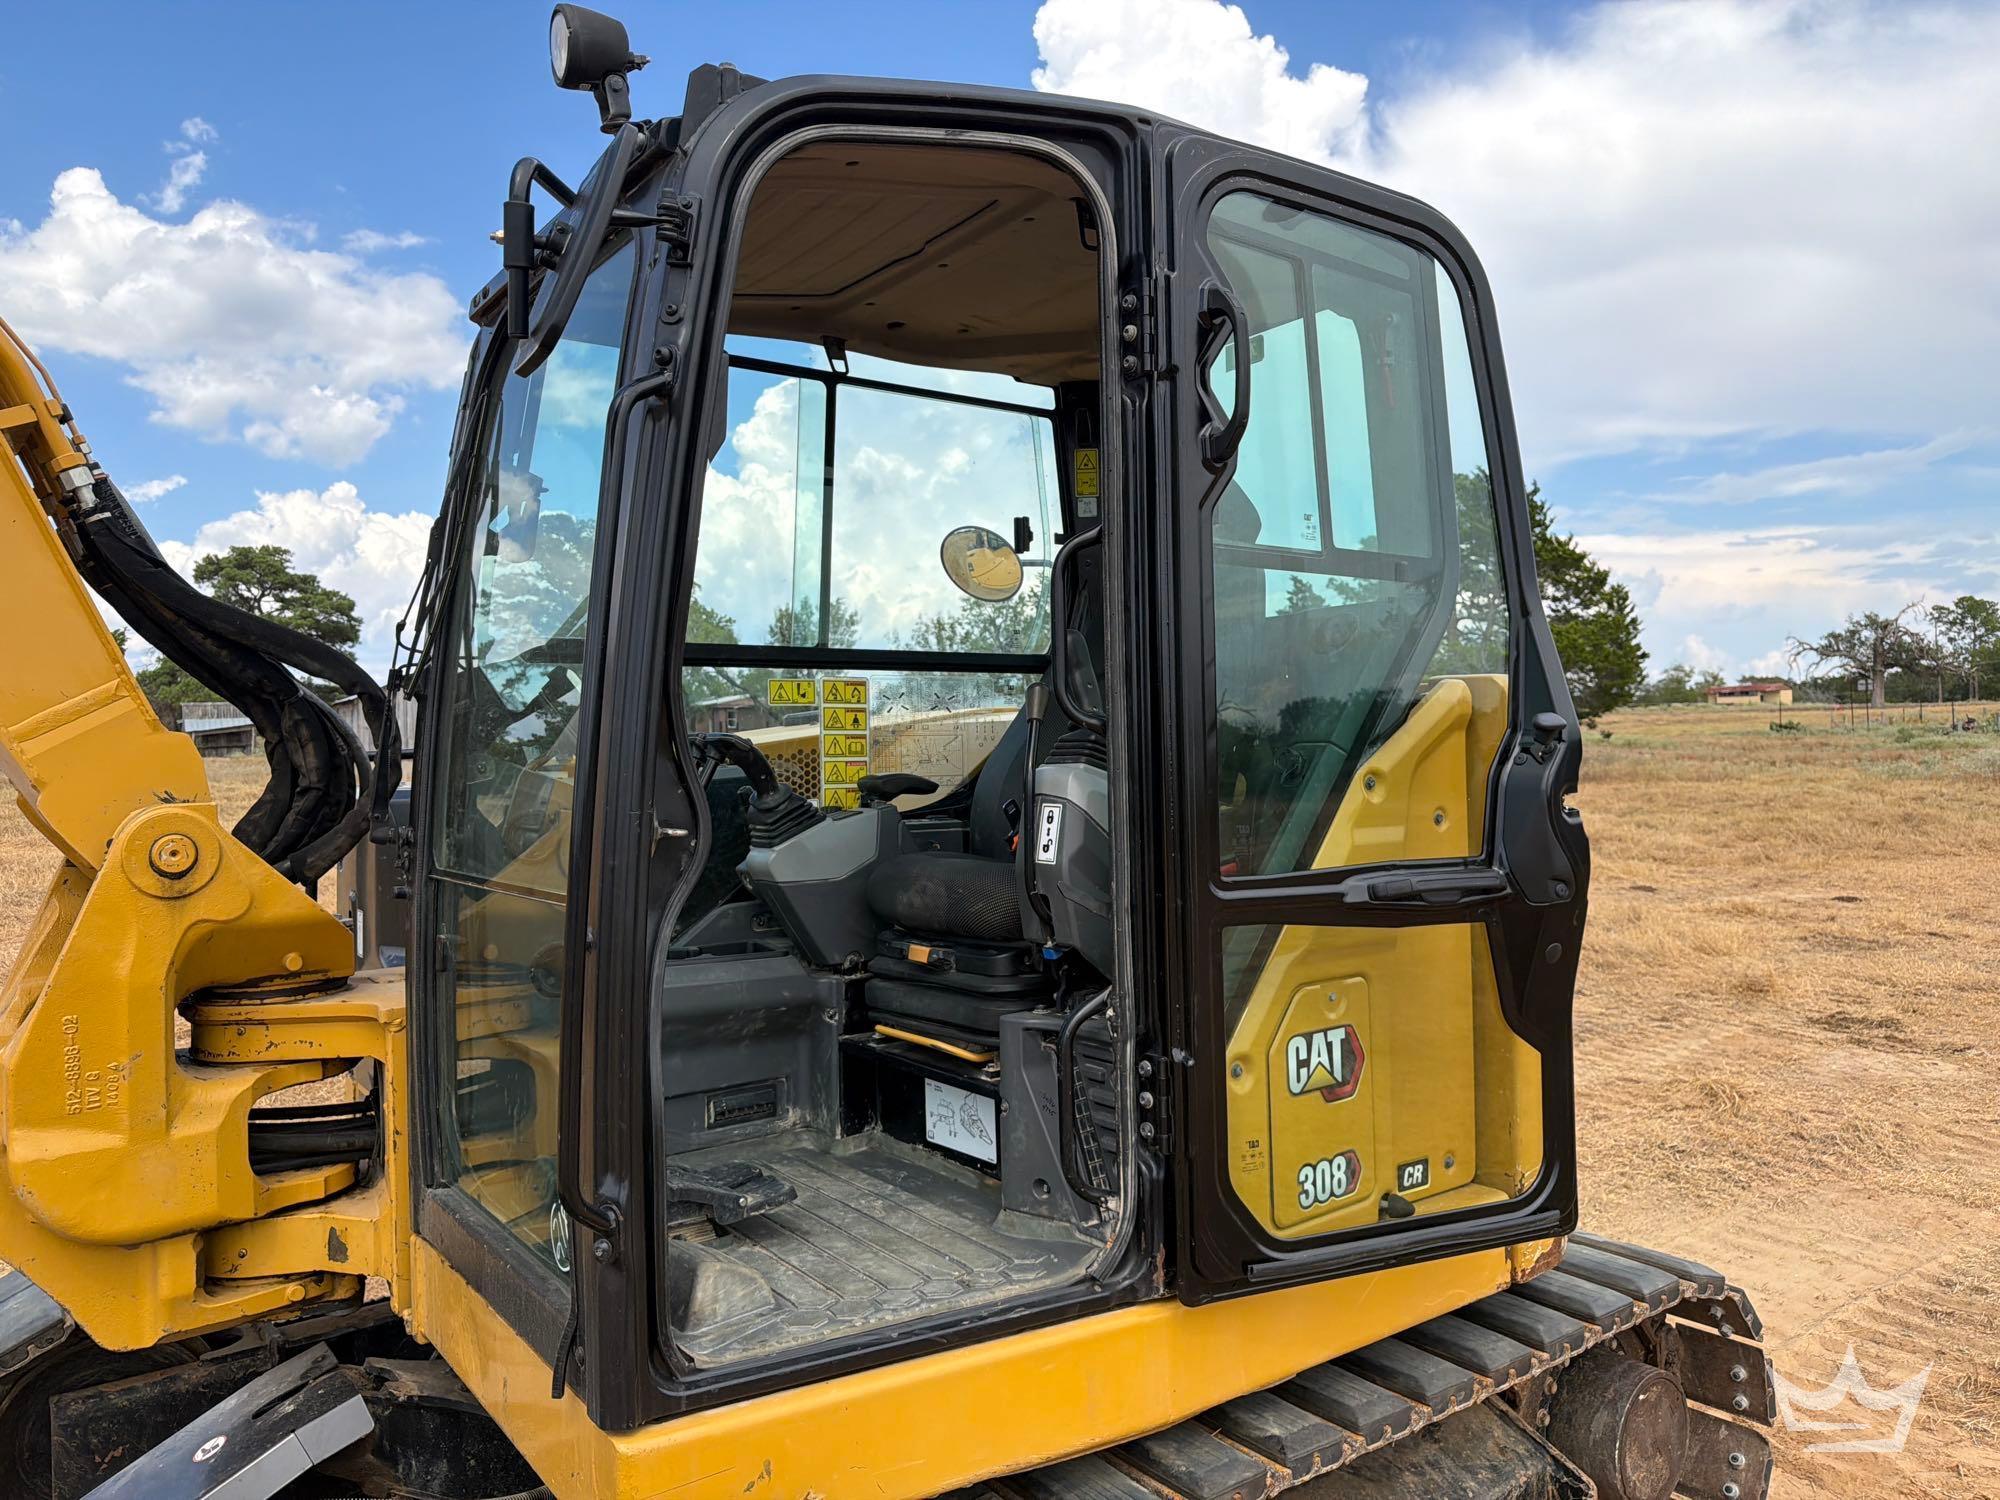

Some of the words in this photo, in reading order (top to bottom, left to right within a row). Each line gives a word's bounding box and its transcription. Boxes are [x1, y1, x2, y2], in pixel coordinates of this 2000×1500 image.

[1287, 1026, 1346, 1095] CAT
[1298, 1155, 1347, 1208] 308
[1403, 1164, 1424, 1187] CR
